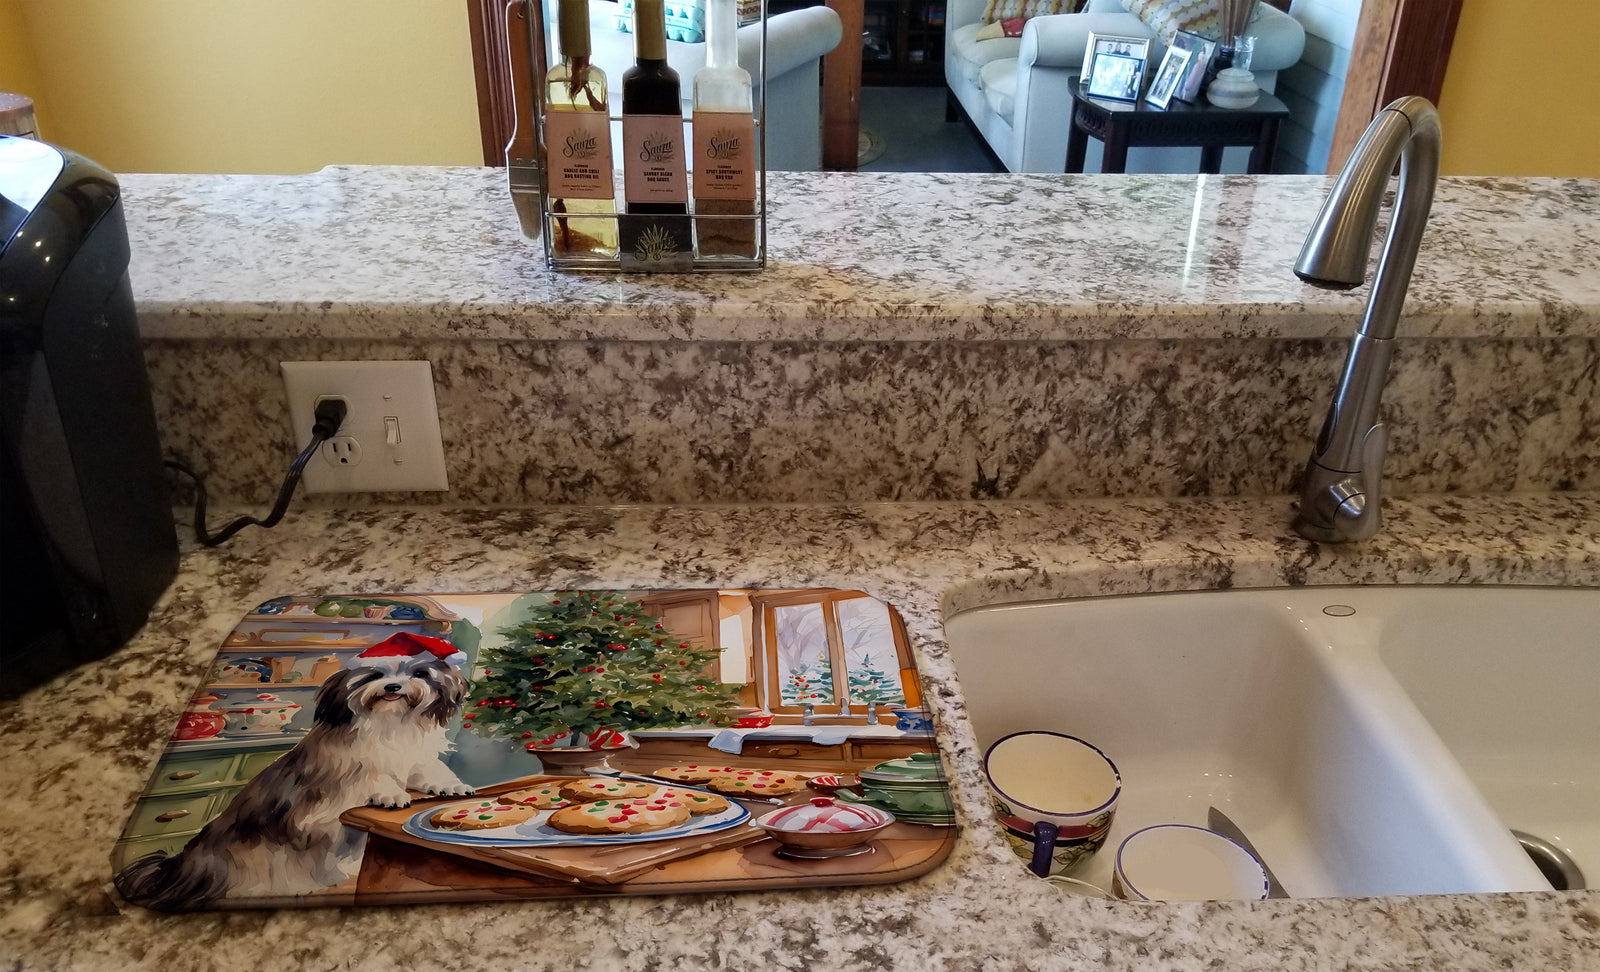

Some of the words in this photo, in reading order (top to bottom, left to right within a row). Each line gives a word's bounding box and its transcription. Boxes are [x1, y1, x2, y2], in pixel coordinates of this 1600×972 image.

[562, 136, 597, 158] Sauza
[640, 140, 674, 162] Sauza
[706, 136, 741, 159] Sauza
